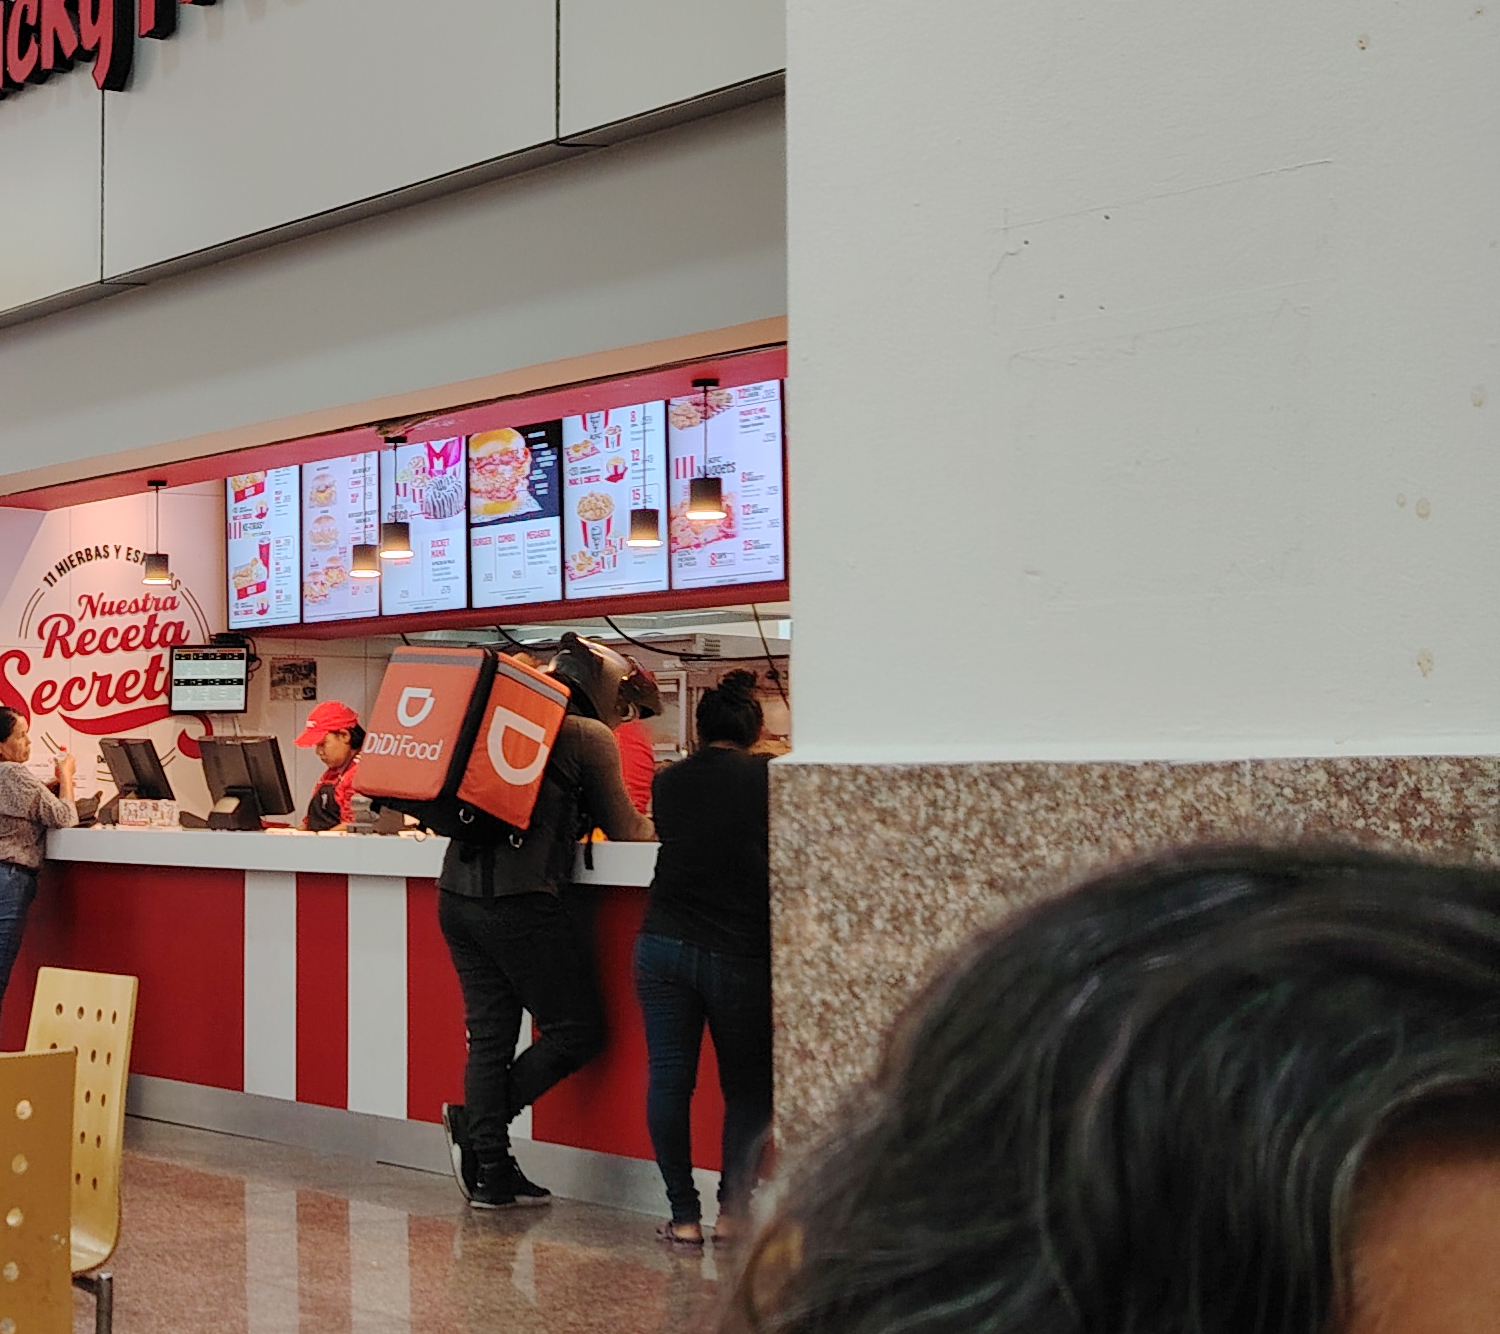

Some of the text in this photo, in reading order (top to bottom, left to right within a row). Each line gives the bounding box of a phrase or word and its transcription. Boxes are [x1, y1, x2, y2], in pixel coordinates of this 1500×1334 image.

[43, 571, 58, 587] 11
[55, 544, 110, 578] HIERBAS
[114, 544, 122, 560] Y
[78, 592, 181, 621] Nuestra
[37, 613, 191, 660] Receta
